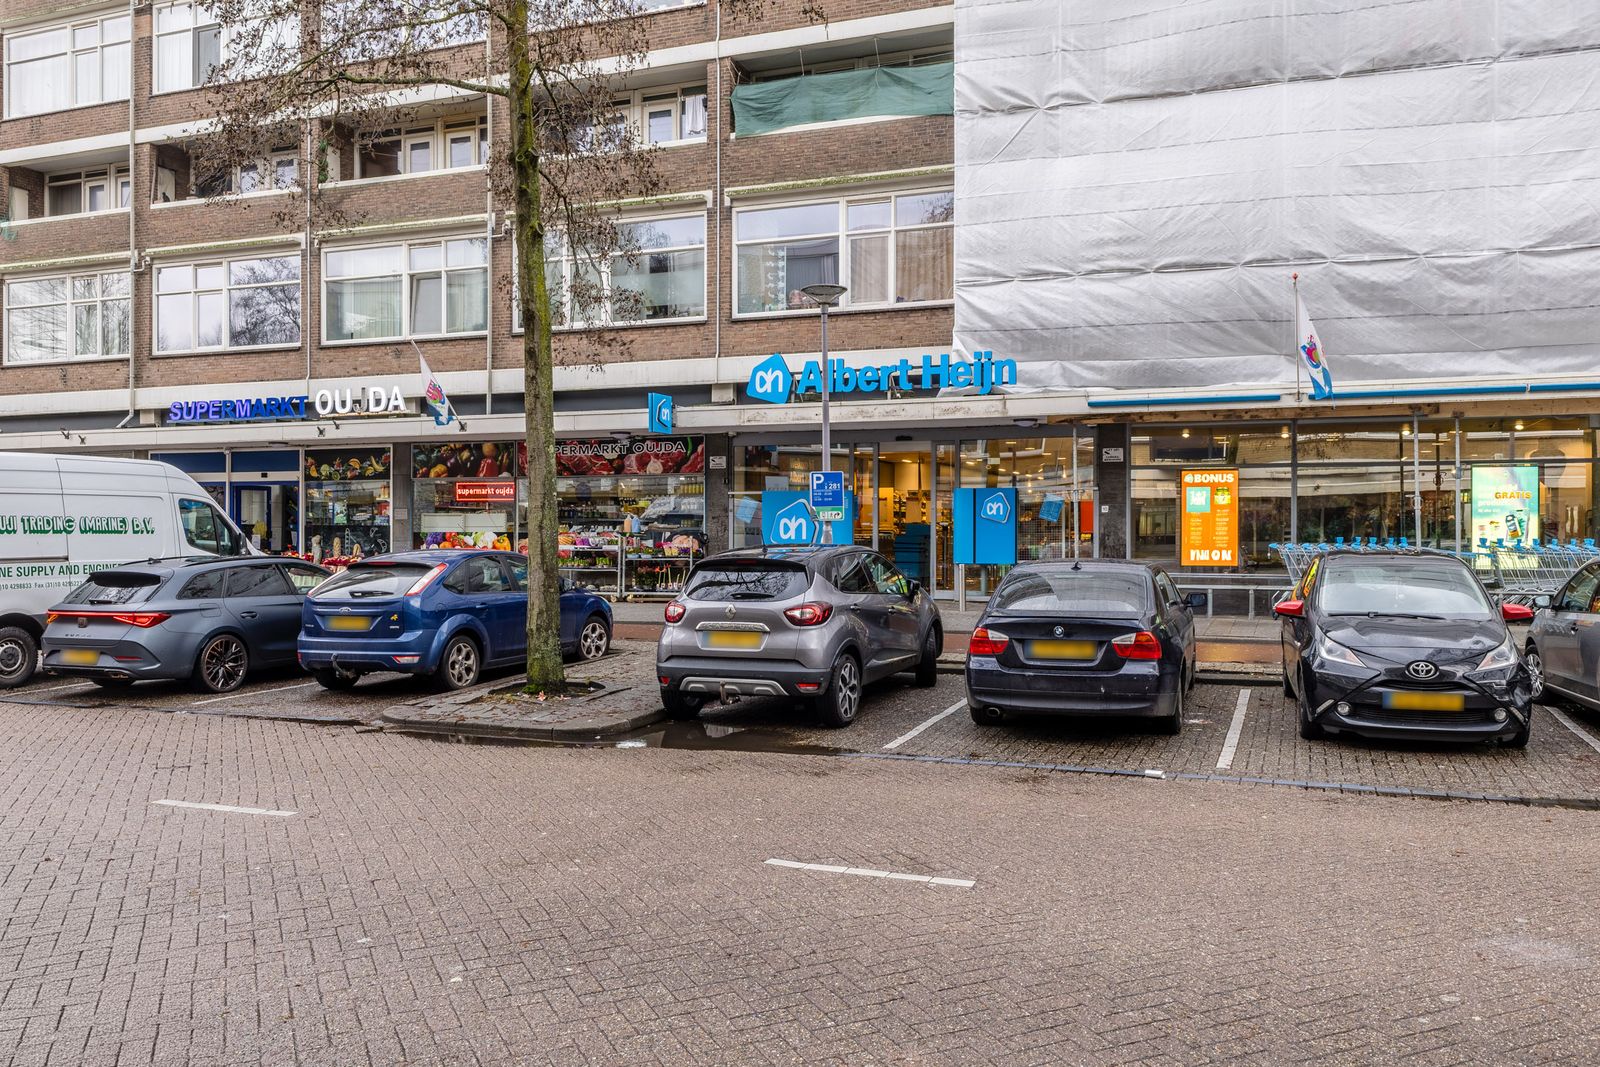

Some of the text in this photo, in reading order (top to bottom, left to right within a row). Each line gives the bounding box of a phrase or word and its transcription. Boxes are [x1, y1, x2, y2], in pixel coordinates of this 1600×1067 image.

[797, 358, 912, 395] Albert
[922, 350, 1017, 395] Heijn
[169, 386, 407, 420] SUPERMARKT OUJDA
[555, 441, 686, 456] PERMARKT OUJDA
[813, 474, 824, 490] P
[1194, 473, 1234, 483] BONUS
[458, 487, 515, 497] supermarkt oujda
[1495, 491, 1531, 499] GRATIS
[21, 516, 76, 534] TRADING
[79, 516, 129, 534] (MARINE)
[132, 517, 155, 534] B.V.
[16, 566, 55, 577] SUPPLY
[58, 565, 80, 575] AND
